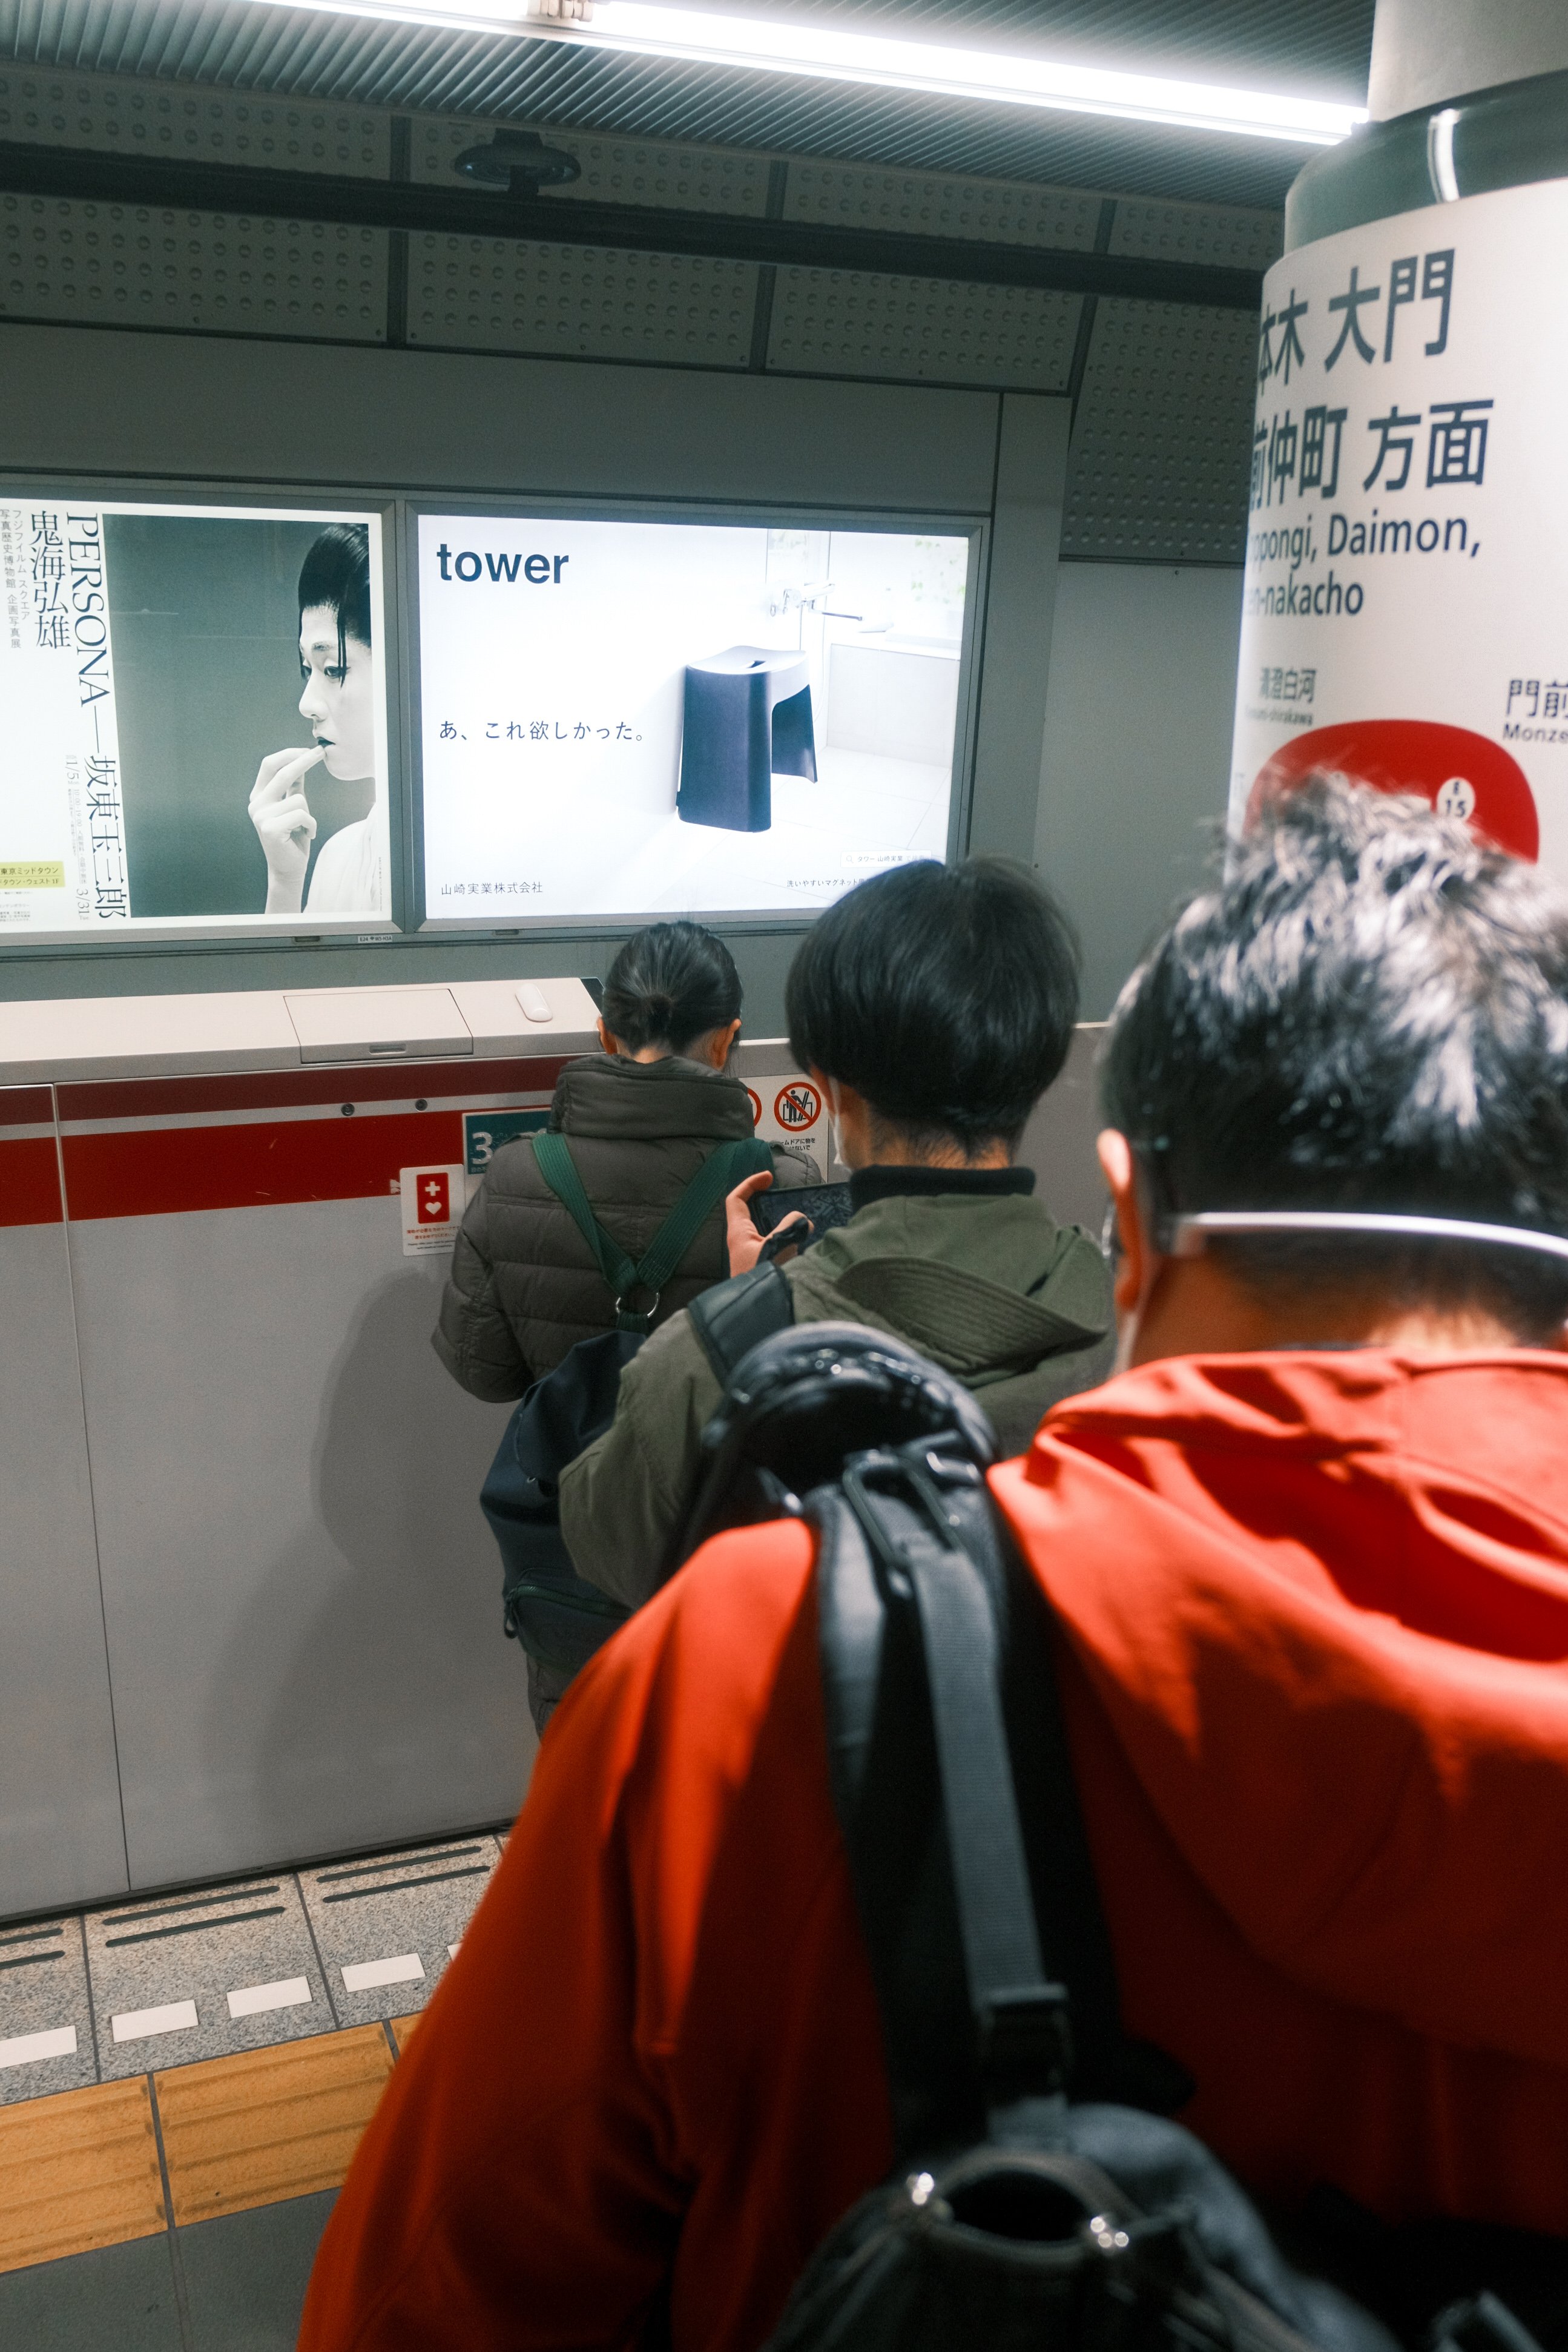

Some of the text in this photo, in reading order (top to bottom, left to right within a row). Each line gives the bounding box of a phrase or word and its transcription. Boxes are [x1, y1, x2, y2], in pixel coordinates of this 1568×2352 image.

[1324, 248, 1455, 372] 大門
[1363, 398, 1494, 493] 方面
[1327, 508, 1481, 558] Daimon,
[30, 510, 72, 649] 鬼海弘雄
[436, 542, 570, 585] tower
[7, 594, 22, 648] 企画写真展
[19, 579, 30, 620] スクエア
[67, 512, 127, 918] PERSONA 坂東玉三郎
[439, 720, 645, 742] あ、これ欲しかった。
[1445, 799, 1466, 819] 15
[76, 888, 91, 915] 3/31
[441, 881, 544, 895] 山崎実業株式会社
[473, 1132, 493, 1164] 3
